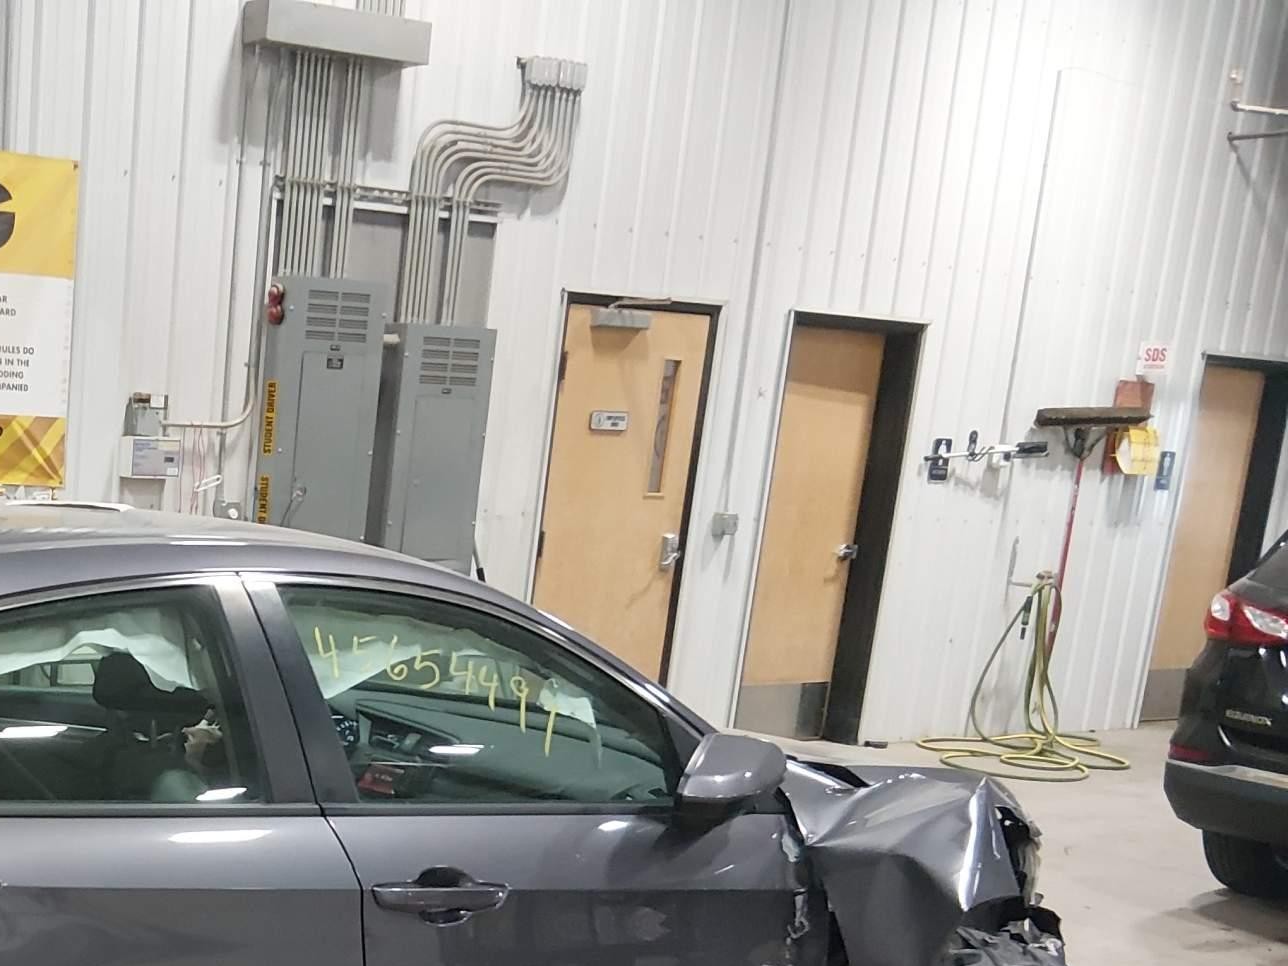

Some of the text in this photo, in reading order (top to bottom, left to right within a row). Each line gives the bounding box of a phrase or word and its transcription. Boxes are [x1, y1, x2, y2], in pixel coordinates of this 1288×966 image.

[23, 347, 34, 355] DO
[1144, 347, 1167, 362] SDS
[5, 358, 14, 366] IN
[17, 359, 30, 367] THE
[263, 382, 276, 454] STUDENT DRIVER
[259, 477, 269, 514] STUDENT
